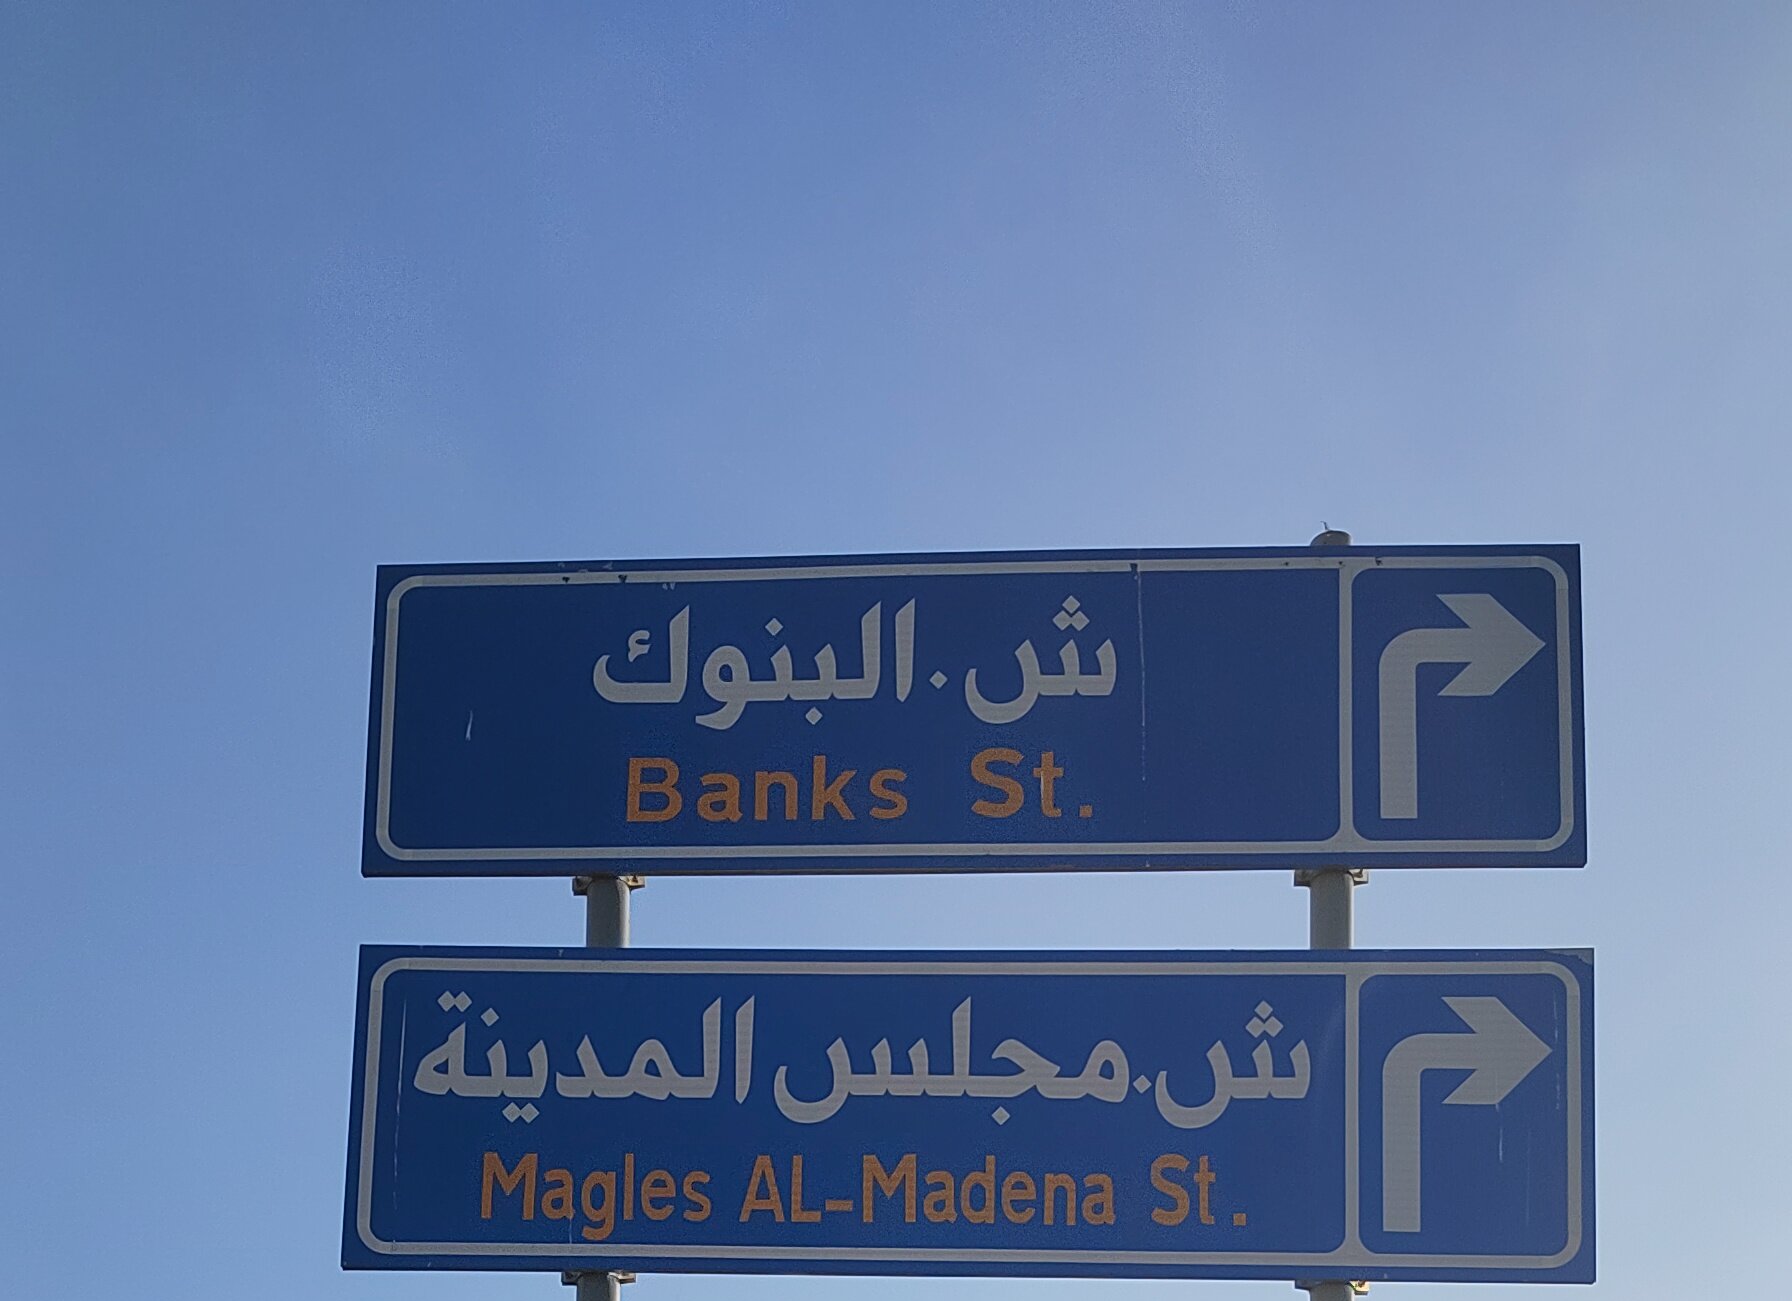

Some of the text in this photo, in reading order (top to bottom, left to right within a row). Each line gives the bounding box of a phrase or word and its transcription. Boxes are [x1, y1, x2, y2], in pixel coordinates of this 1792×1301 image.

[624, 746, 1095, 824] Banks St.
[411, 990, 757, 1124] المدينة
[479, 1150, 1248, 1243] Magles AL-Madena St.
